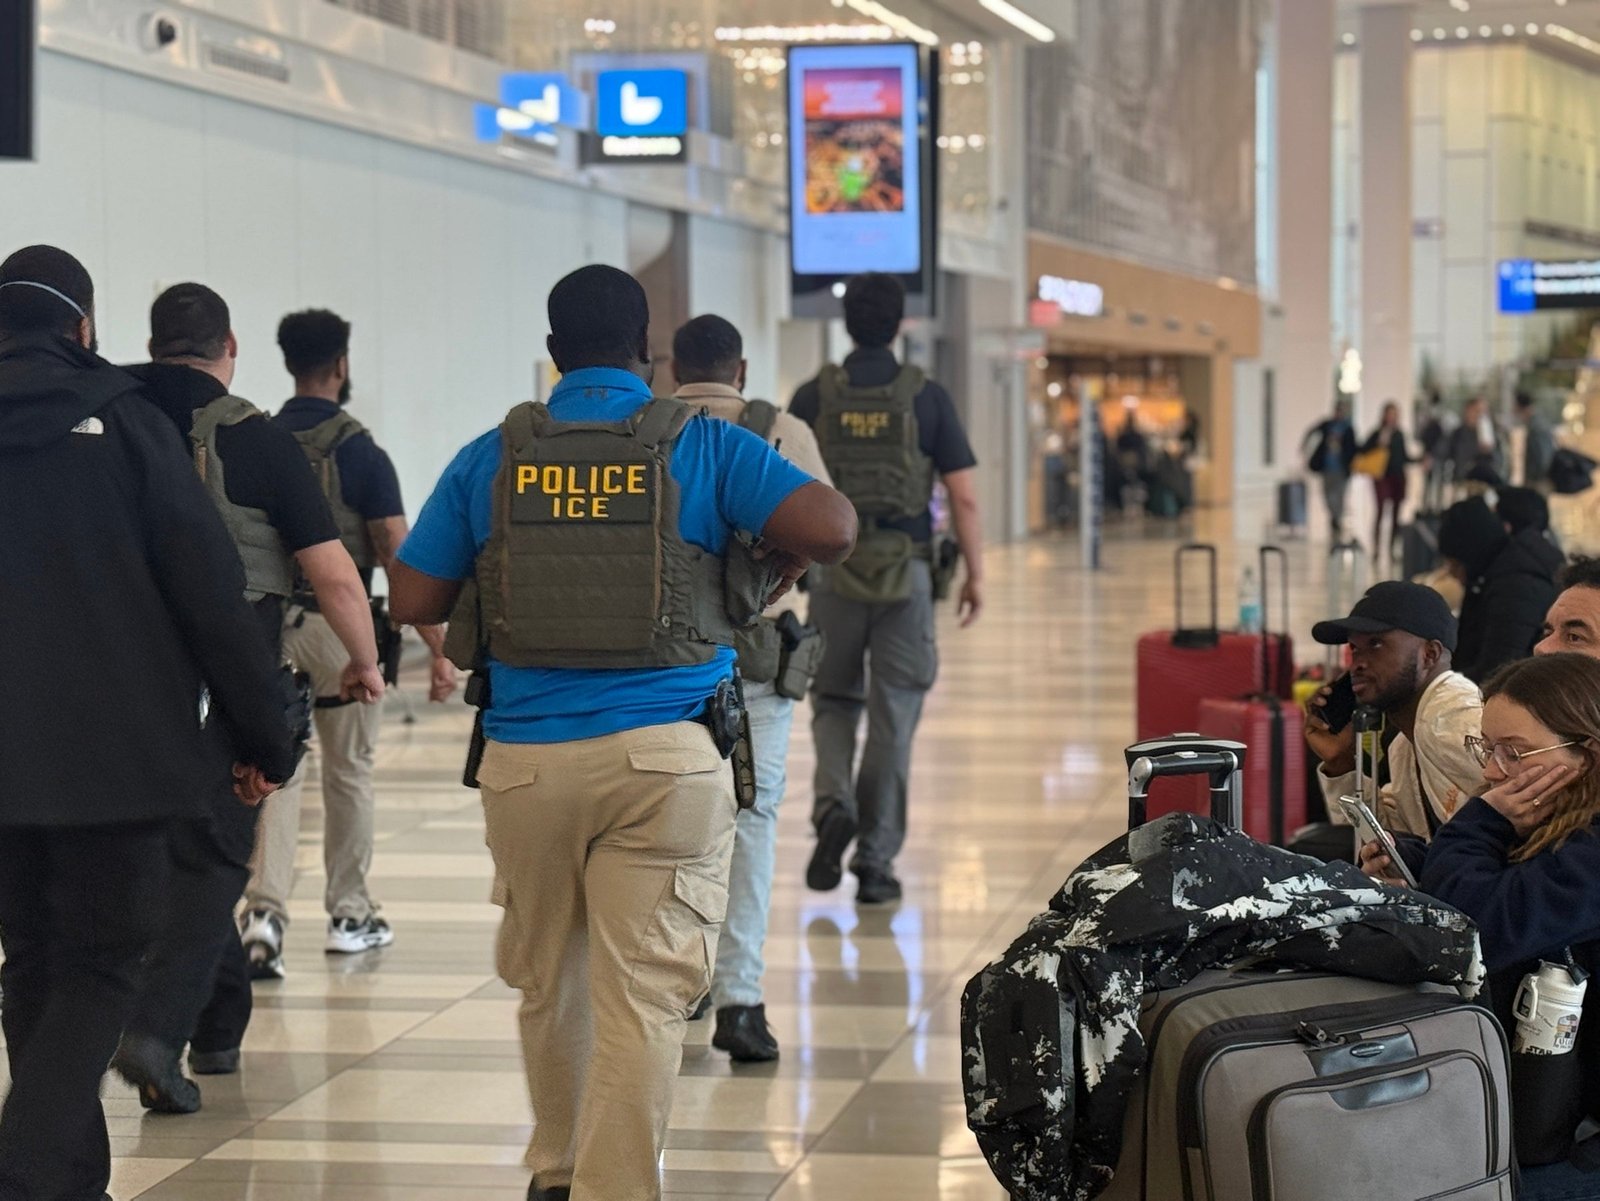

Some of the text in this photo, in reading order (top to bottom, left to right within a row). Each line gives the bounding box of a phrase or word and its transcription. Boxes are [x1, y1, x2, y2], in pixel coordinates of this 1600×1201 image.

[840, 411, 889, 427] POLICE
[852, 427, 877, 438] ICE
[516, 464, 647, 494] POLICE
[552, 496, 610, 518] ICE
